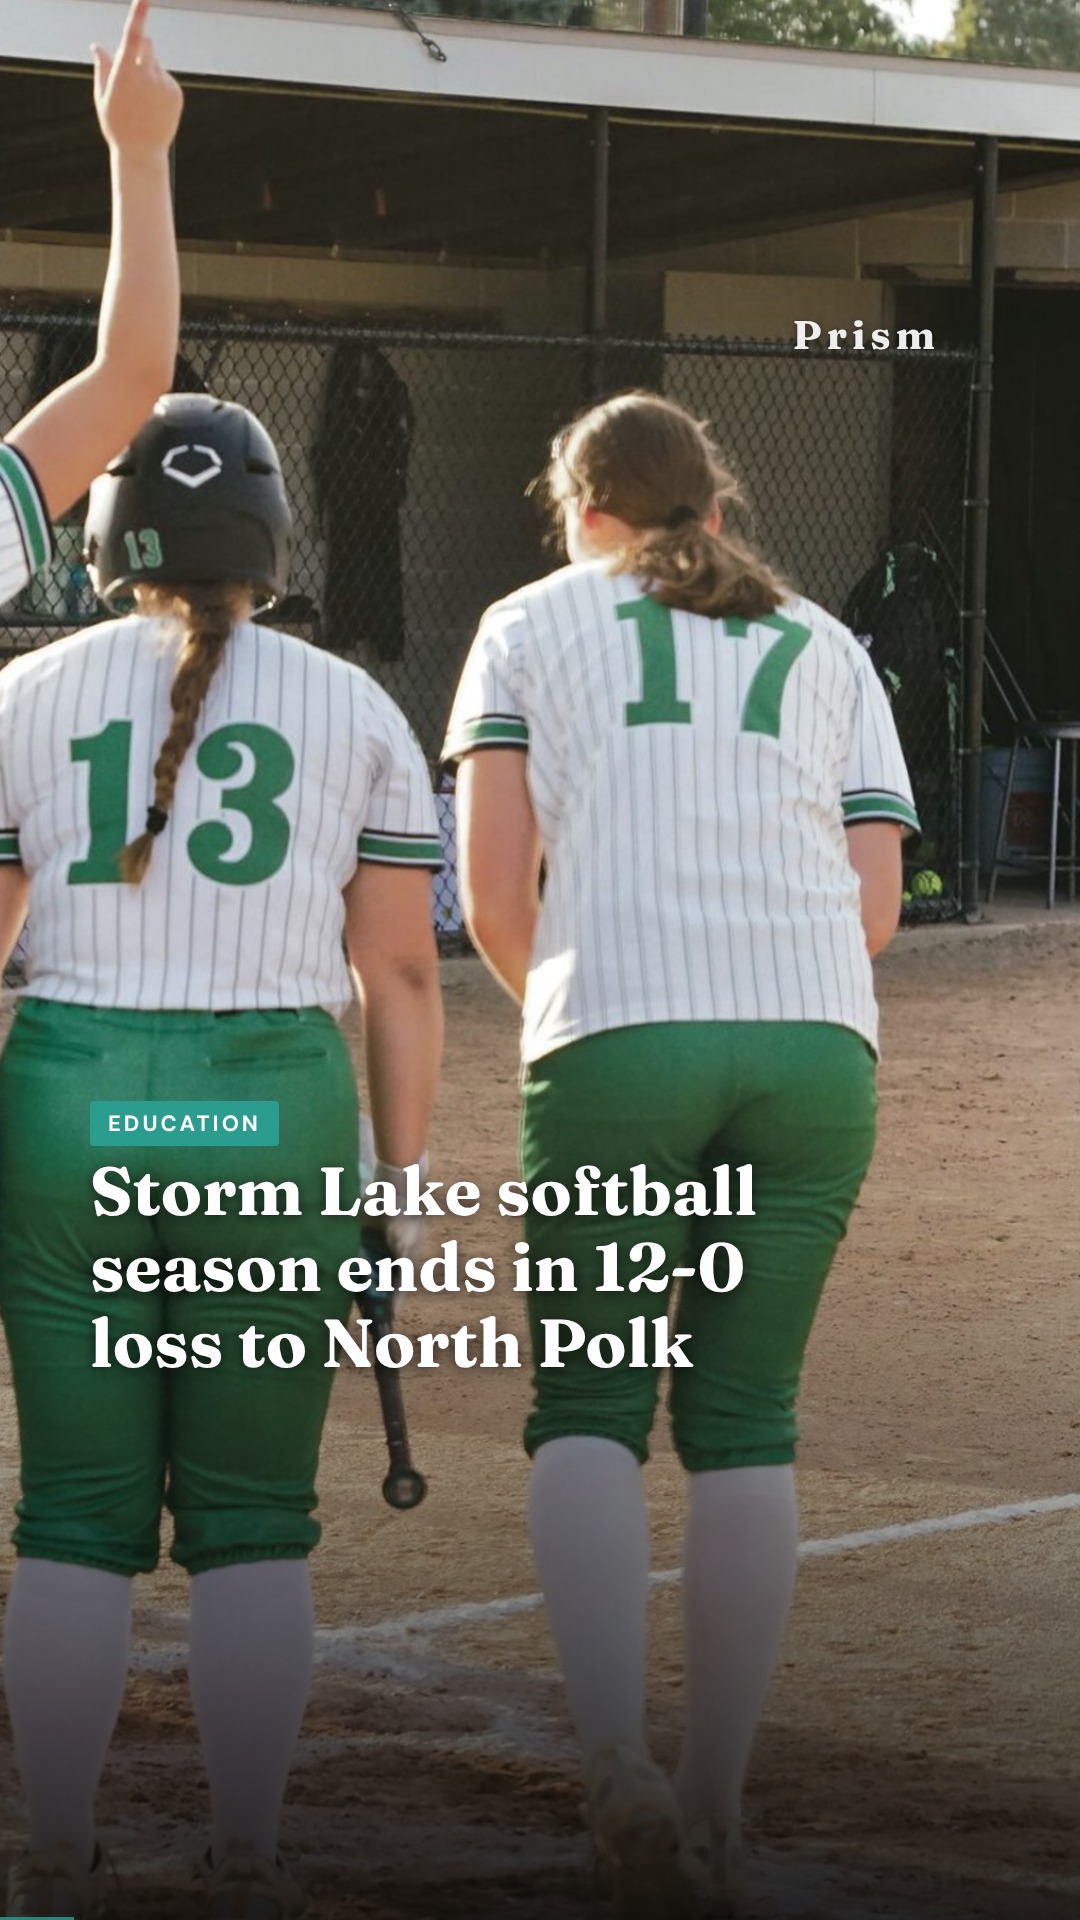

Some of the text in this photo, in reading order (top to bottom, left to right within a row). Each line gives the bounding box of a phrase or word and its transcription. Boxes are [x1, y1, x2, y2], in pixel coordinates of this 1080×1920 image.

[124, 528, 163, 569] 13
[615, 593, 813, 740] 17
[67, 719, 295, 886] 13
